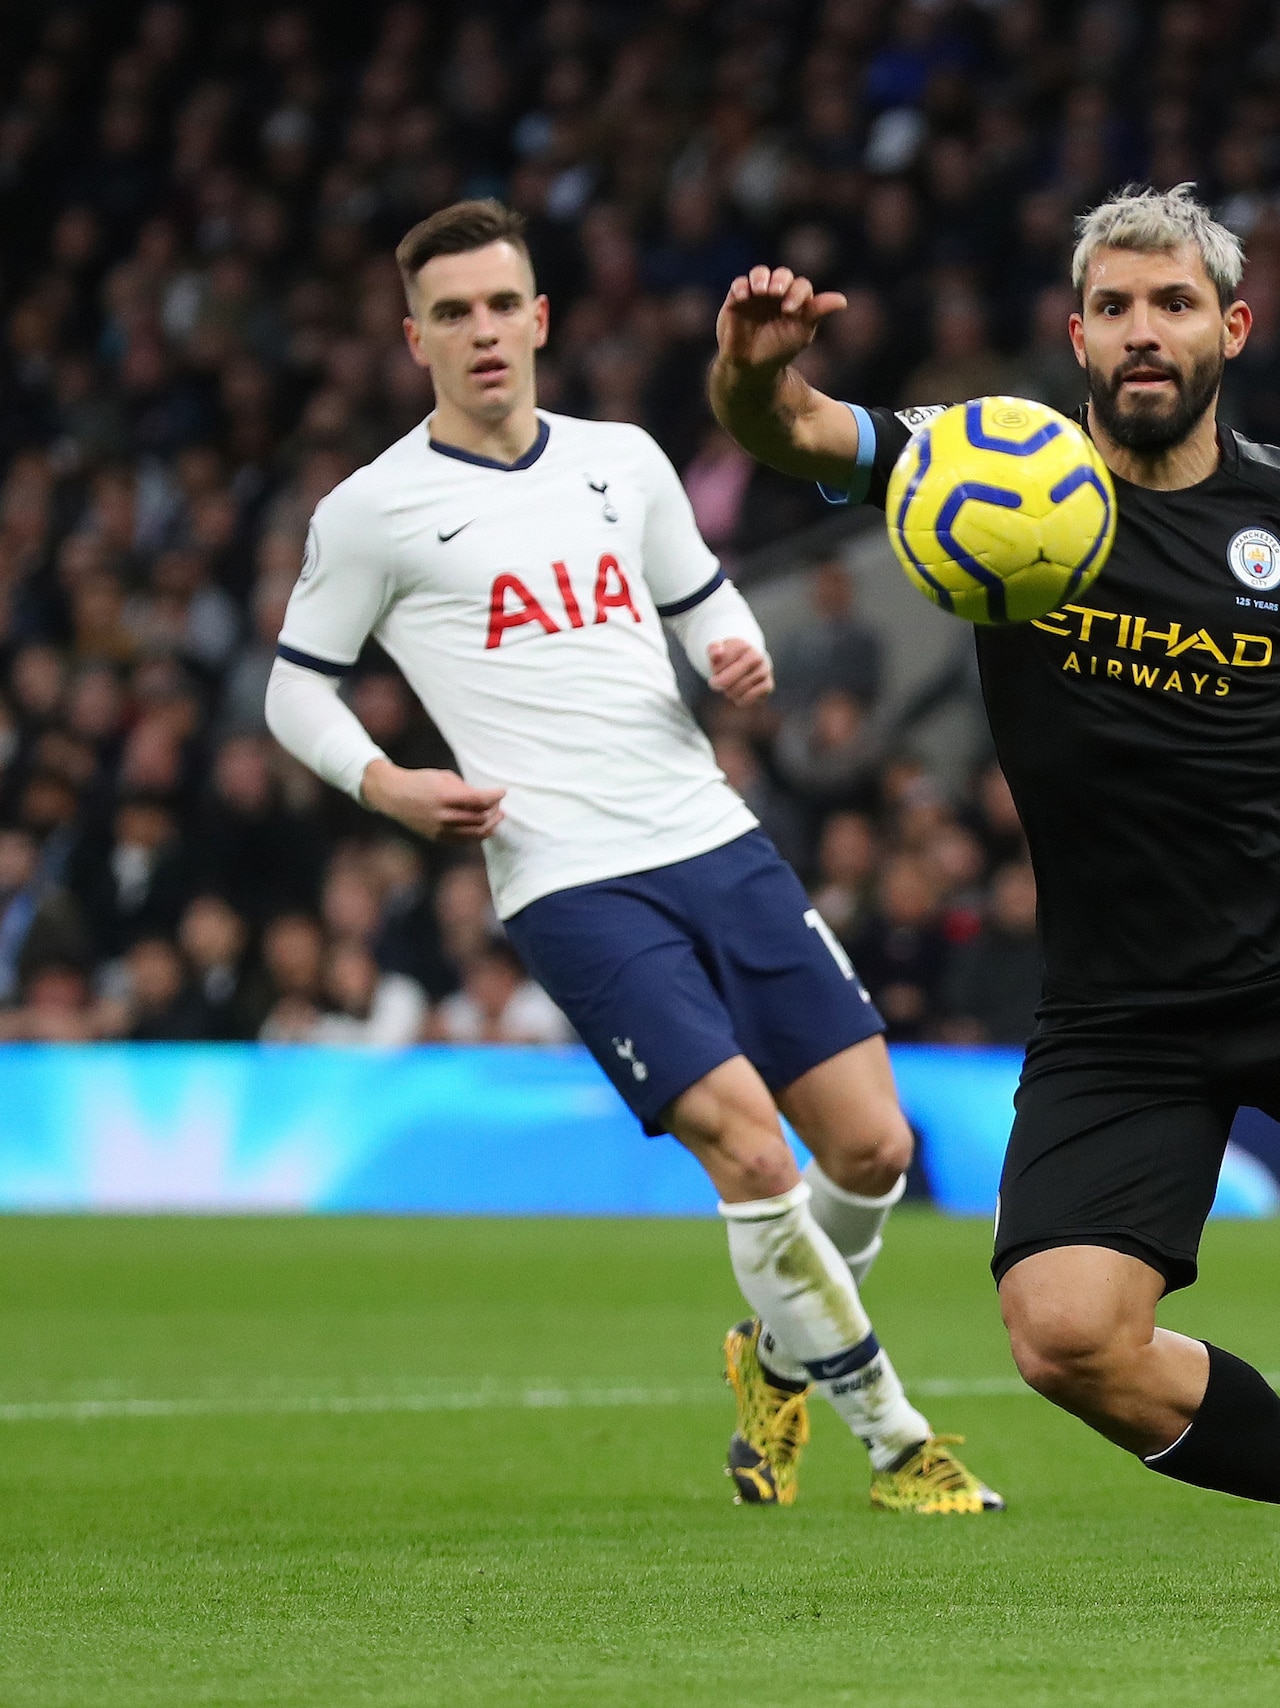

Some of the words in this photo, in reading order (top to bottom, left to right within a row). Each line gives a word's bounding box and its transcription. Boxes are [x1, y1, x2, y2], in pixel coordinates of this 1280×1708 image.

[1234, 531, 1280, 554] MANCHESTER
[1250, 579, 1268, 587] CITY
[484, 553, 642, 650] AIA
[1235, 596, 1251, 607] 125
[1253, 600, 1279, 611] YEARS
[1030, 603, 1273, 667] ETIHAD
[1062, 651, 1231, 696] AIRWAYS
